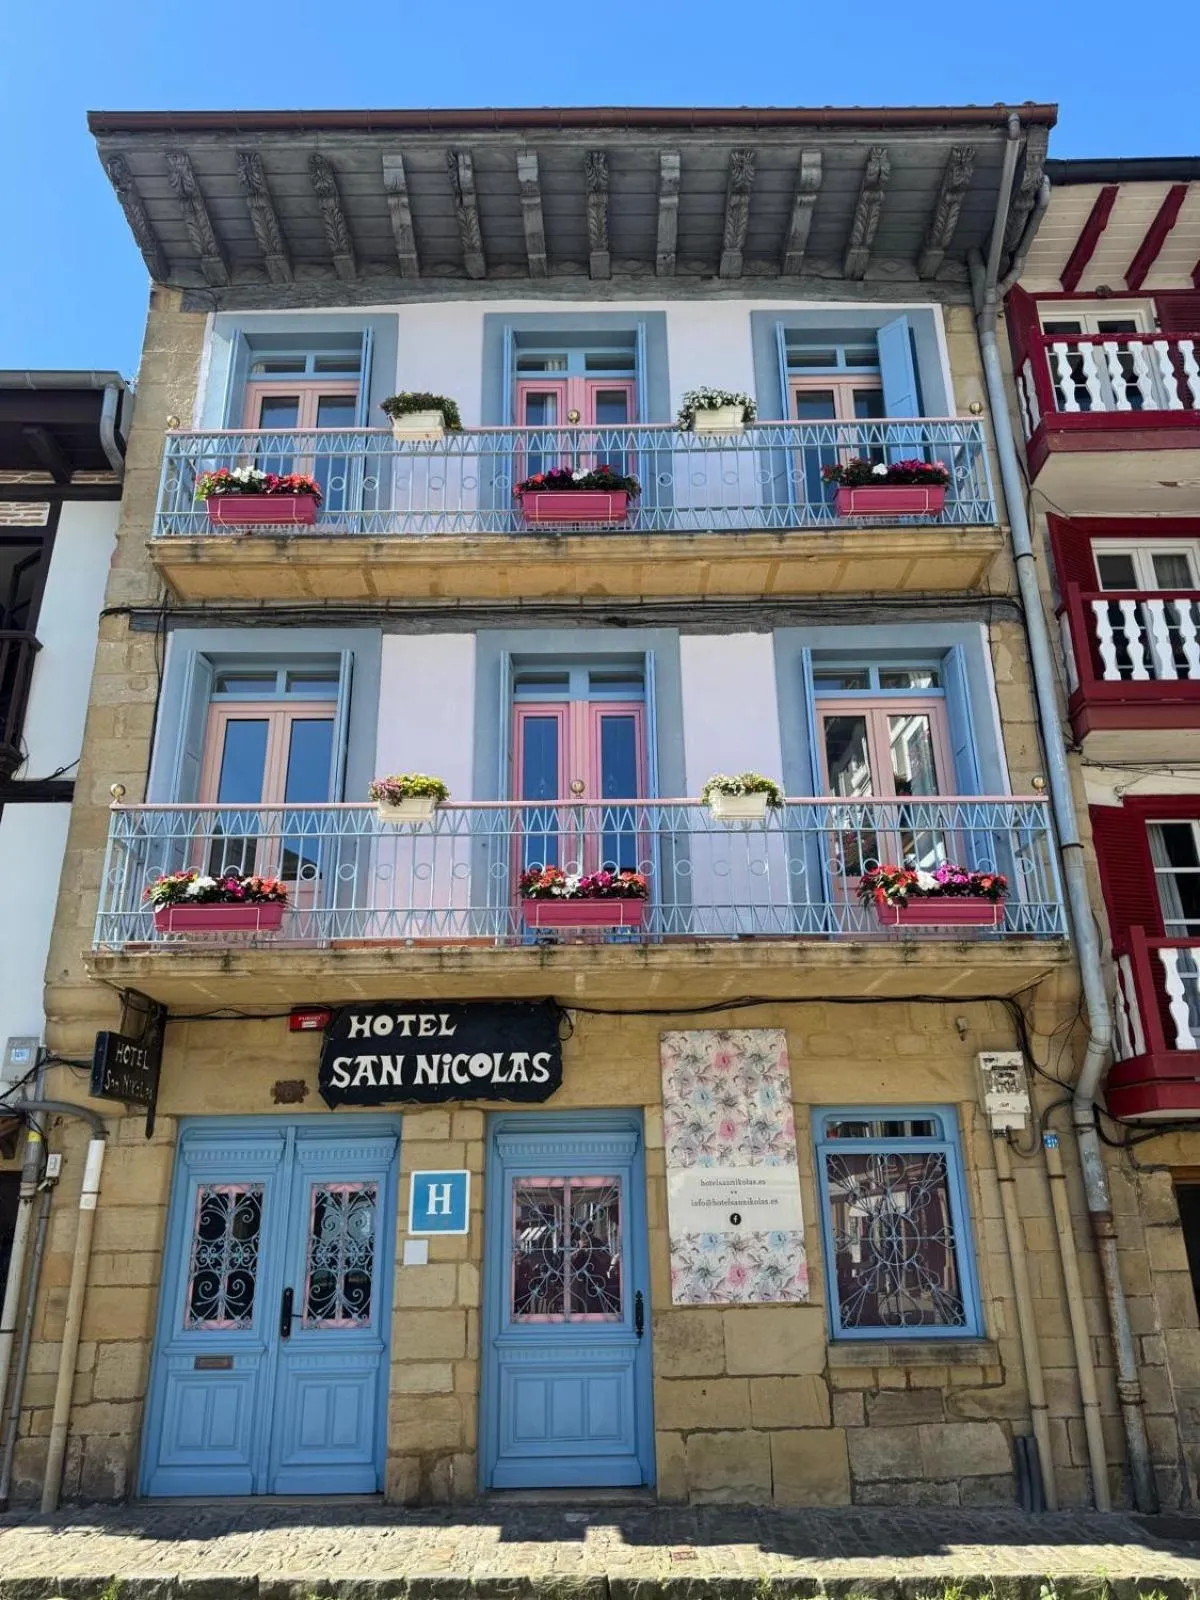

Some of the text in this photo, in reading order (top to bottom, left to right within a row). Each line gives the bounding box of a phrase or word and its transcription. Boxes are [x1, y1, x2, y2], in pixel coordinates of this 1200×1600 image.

[347, 1013, 458, 1039] HOTEL
[115, 1042, 150, 1071] HOTEL
[329, 1054, 405, 1089] SAN
[425, 1183, 453, 1215] H
